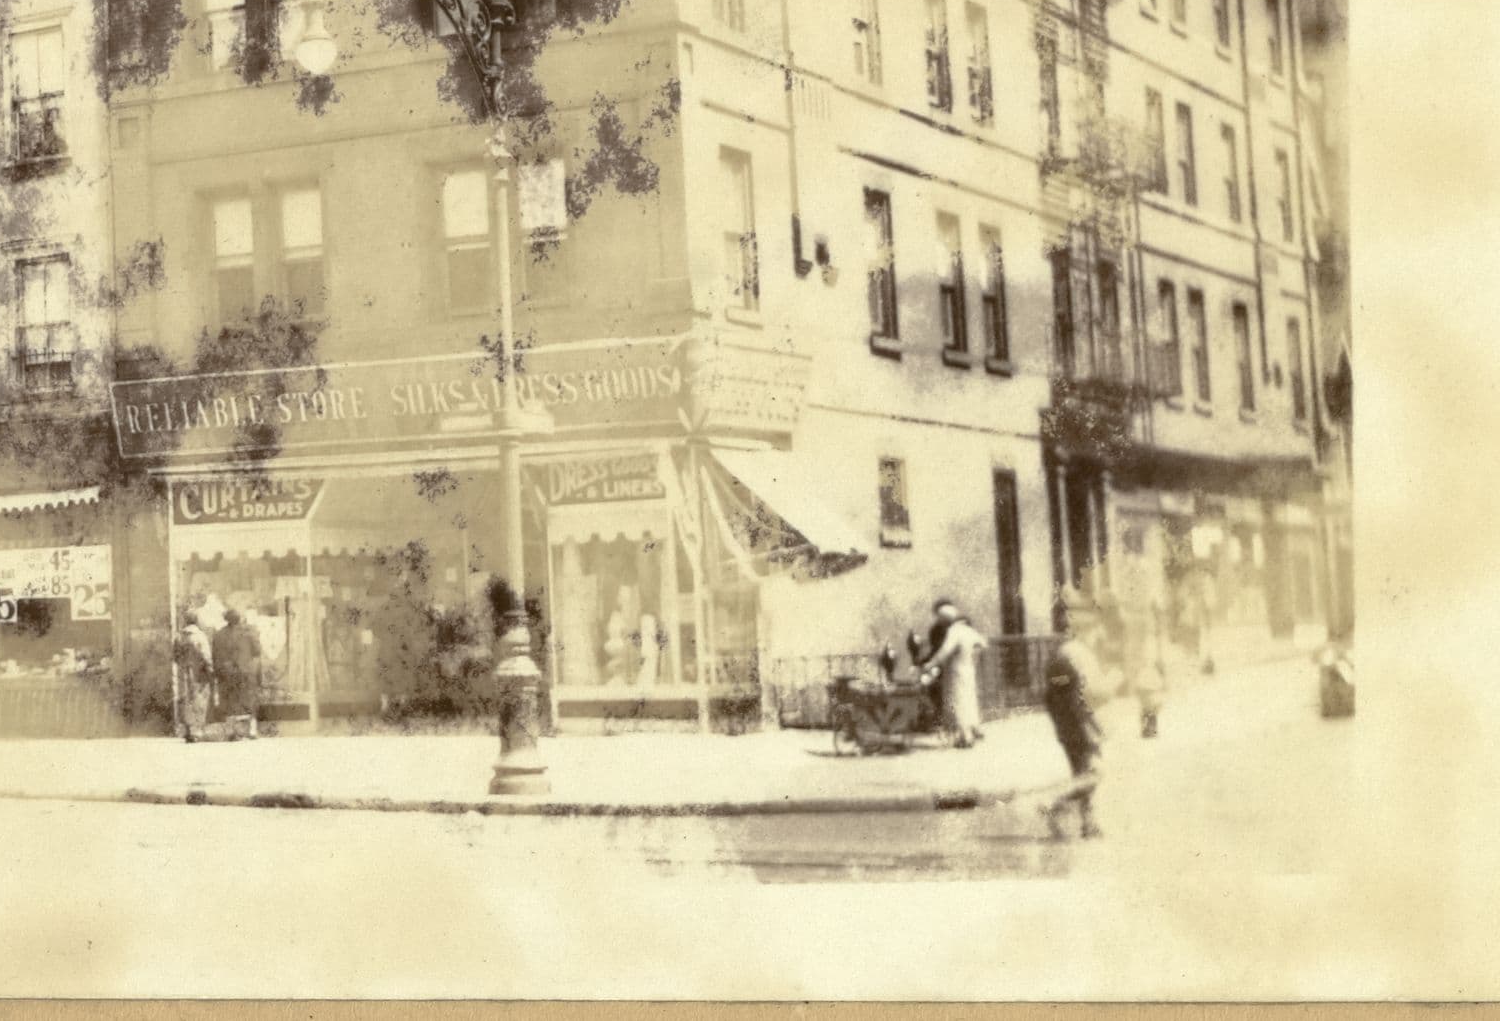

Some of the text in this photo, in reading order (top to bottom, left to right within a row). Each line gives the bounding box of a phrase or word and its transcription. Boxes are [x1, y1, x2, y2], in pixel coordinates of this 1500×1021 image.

[125, 395, 264, 434] RELIABLE
[277, 387, 367, 425] STORE
[390, 379, 464, 415] SILKS
[584, 364, 674, 402] GOODS
[179, 478, 312, 520] CURTAINS
[242, 501, 303, 519] DRAPES
[74, 582, 110, 618] 25
